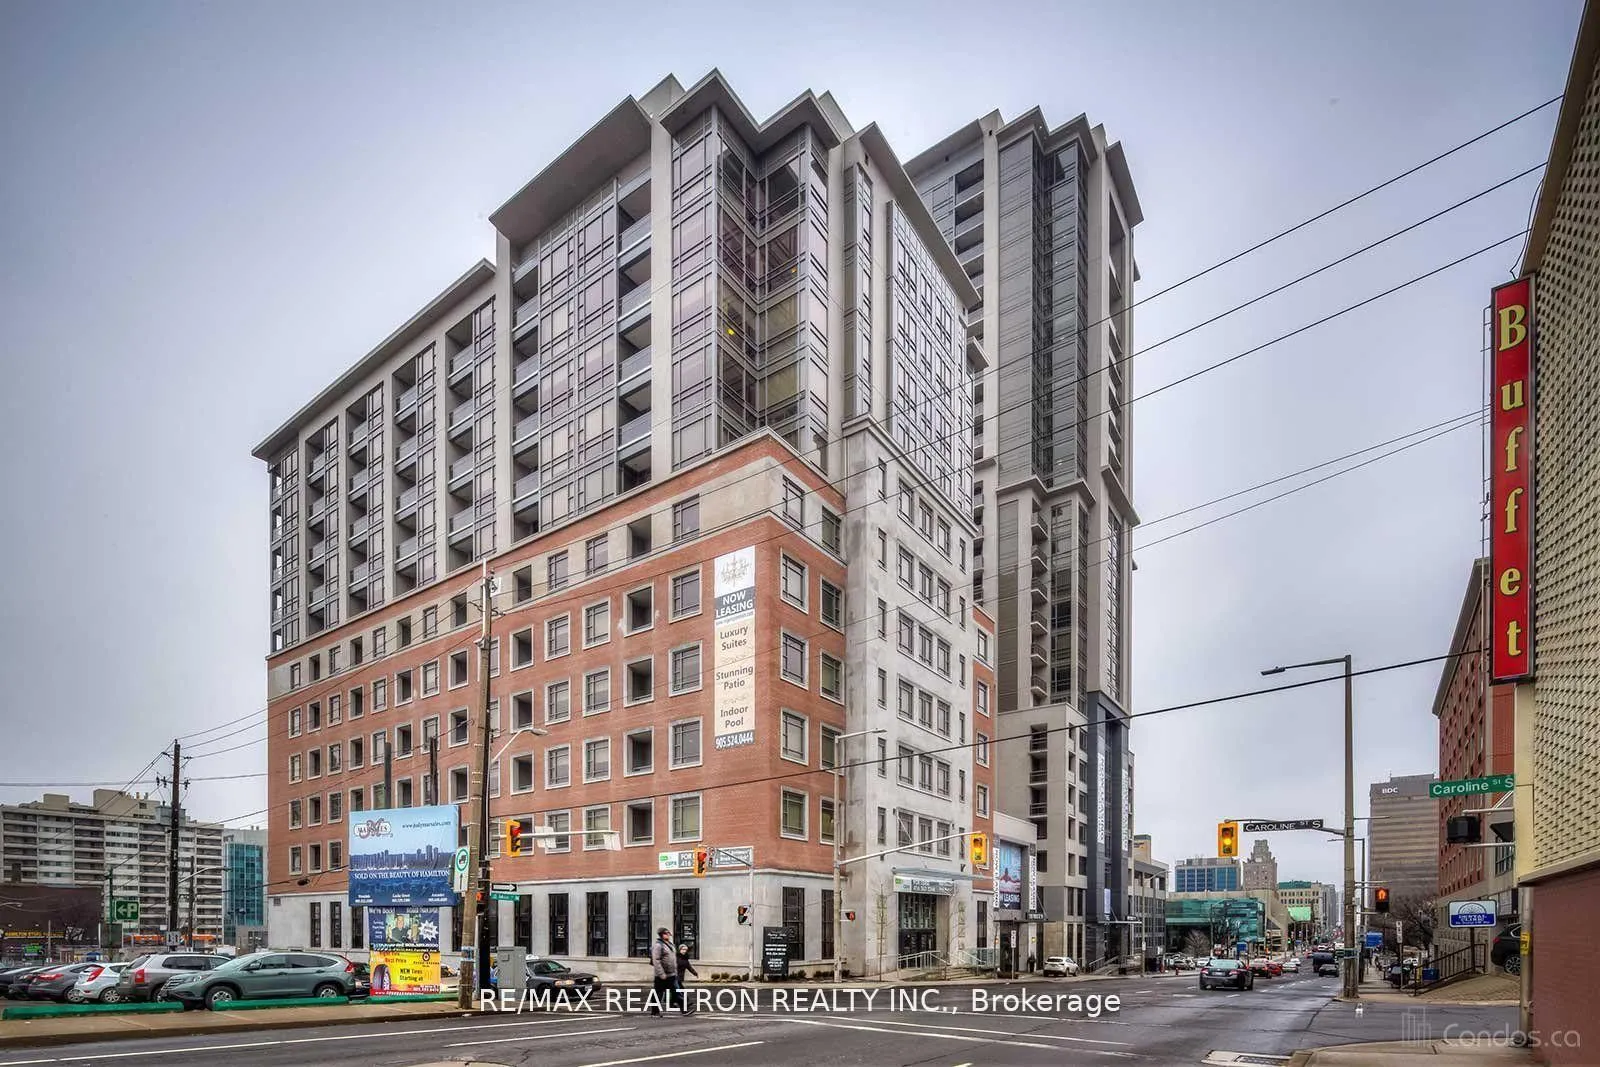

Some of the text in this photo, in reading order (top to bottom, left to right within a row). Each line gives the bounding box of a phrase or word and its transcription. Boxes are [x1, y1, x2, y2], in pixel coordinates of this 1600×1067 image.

[1498, 303, 1528, 657] Buffet
[722, 590, 746, 606] NOW
[715, 599, 754, 619] LEASING
[720, 625, 749, 640] Luxury
[721, 638, 747, 651] Suites
[715, 666, 754, 681] Stunning
[723, 679, 746, 691] Patio
[720, 705, 749, 718] Indoor
[724, 716, 744, 729] Pool
[1433, 777, 1514, 795] Caroline St S
[1245, 823, 1296, 832] CAROLINE
[1312, 820, 1321, 829] S
[354, 872, 368, 880] SOLD
[378, 871, 389, 879] THE
[390, 871, 411, 879] BEAUTY
[412, 870, 420, 878] OF
[420, 869, 450, 878] HAMILTON
[127, 903, 138, 918] P
